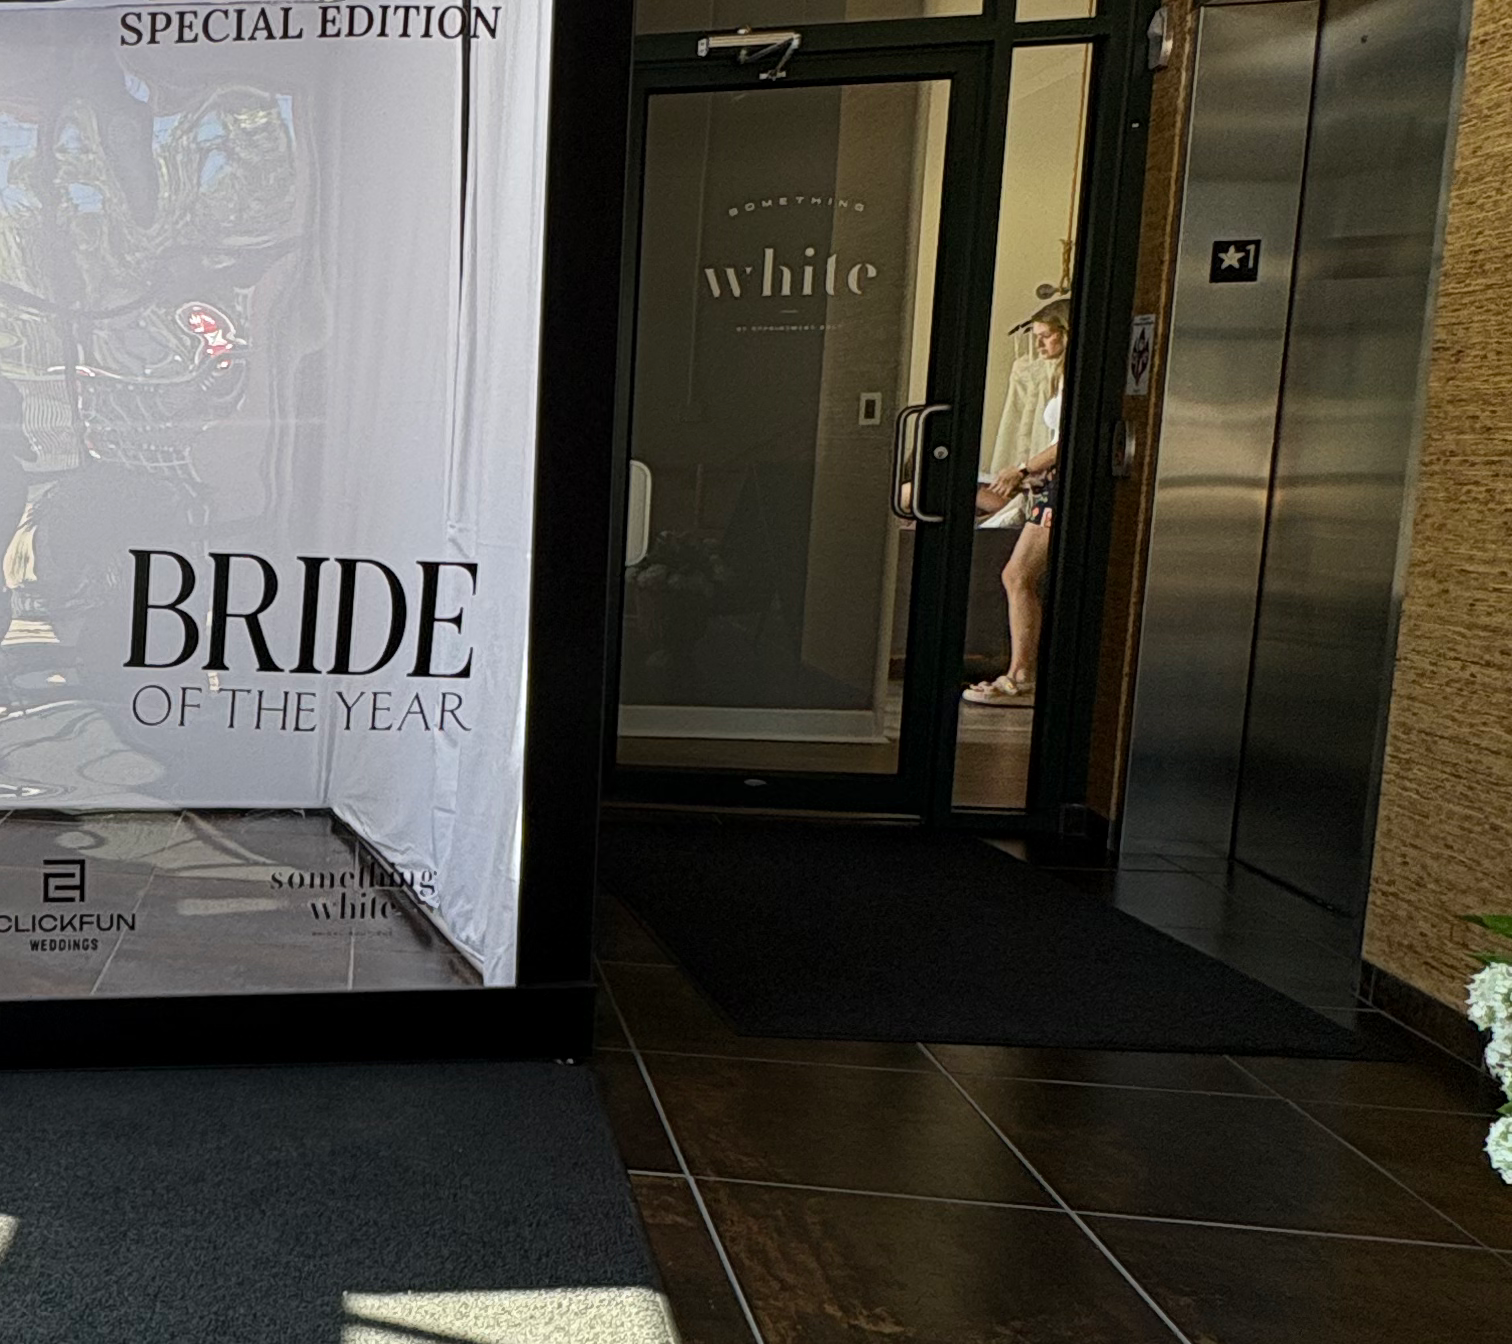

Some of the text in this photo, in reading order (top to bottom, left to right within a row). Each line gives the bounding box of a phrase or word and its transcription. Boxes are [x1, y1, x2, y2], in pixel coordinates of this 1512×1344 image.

[119, 4, 502, 47] SPECIAL EDITION
[728, 196, 865, 218] SOMETHING
[704, 247, 878, 299] white
[1245, 244, 1256, 270] 1
[122, 548, 479, 679] BRIDE
[132, 684, 472, 732] OF THE YEAR
[310, 892, 396, 920] white
[29, 938, 99, 952] WEDDINGS
